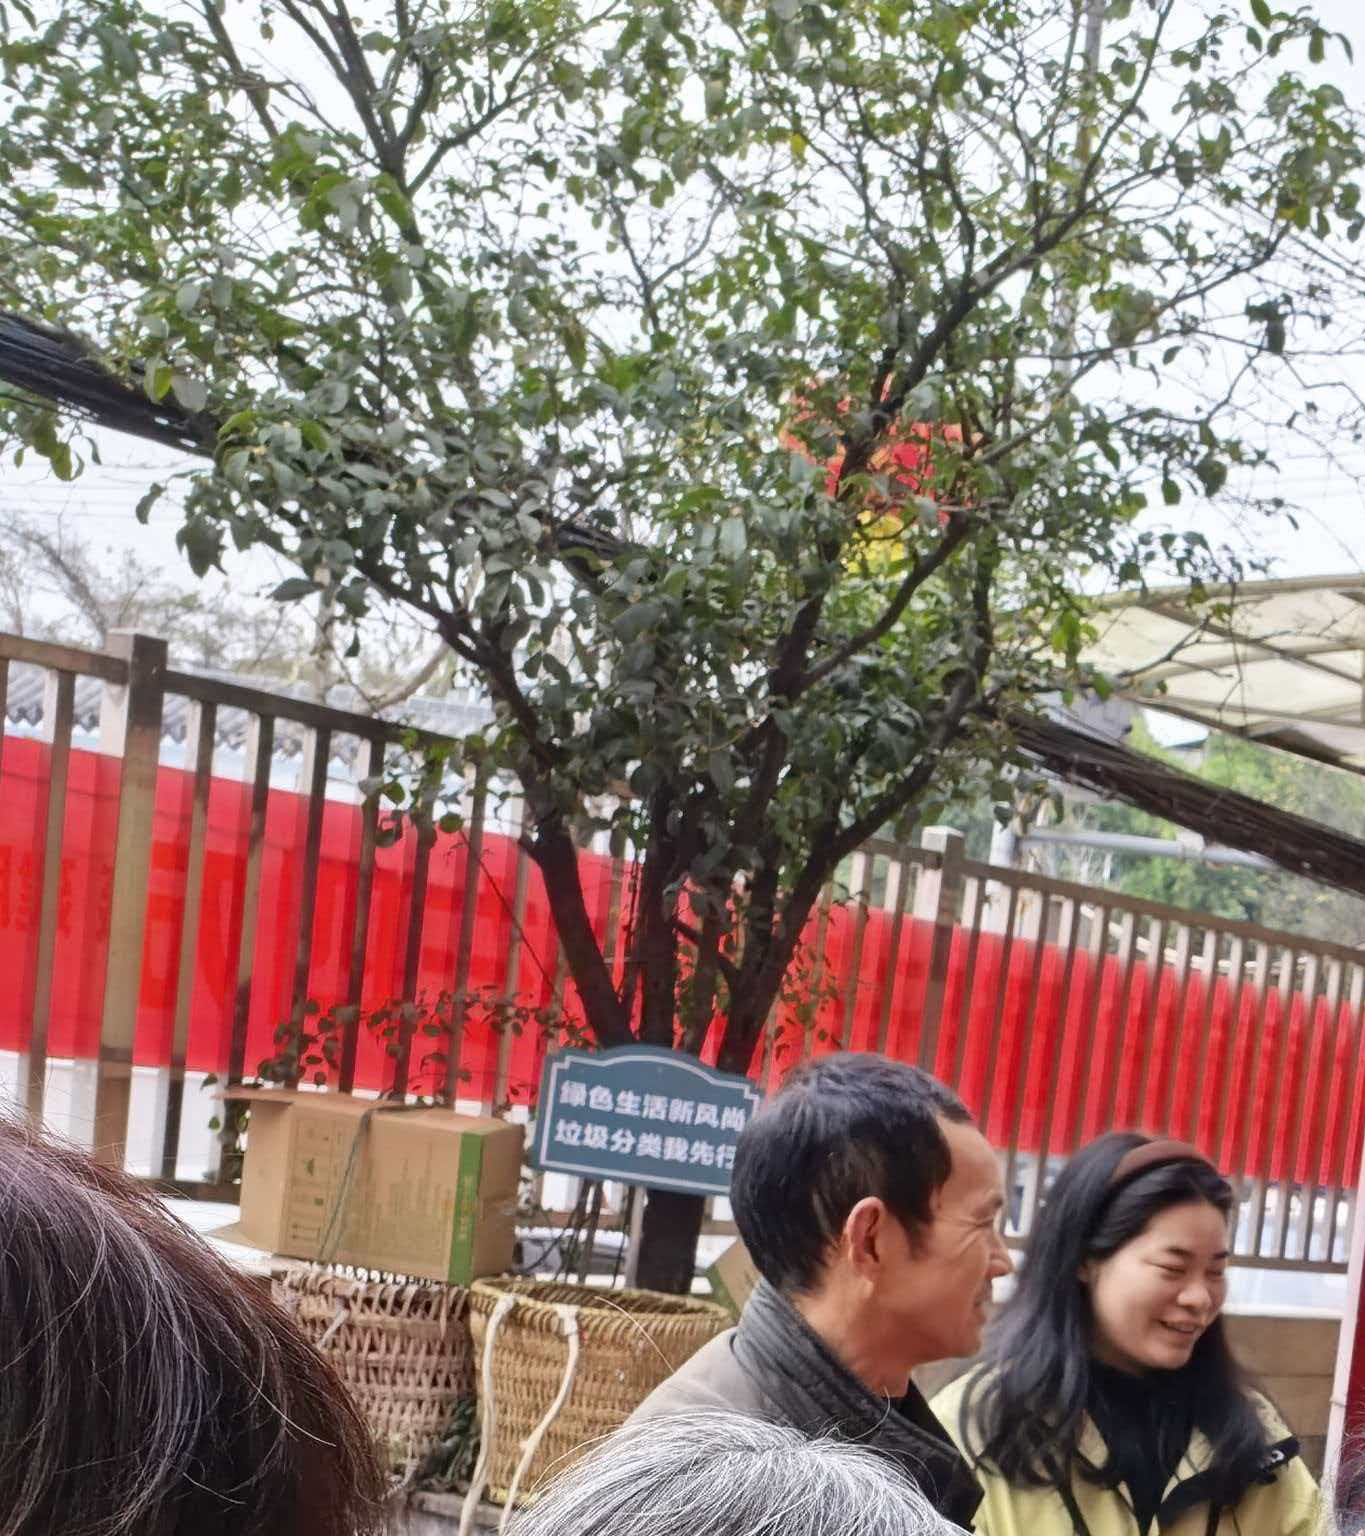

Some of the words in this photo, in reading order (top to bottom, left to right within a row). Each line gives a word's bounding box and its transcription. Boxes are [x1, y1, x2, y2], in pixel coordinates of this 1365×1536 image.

[559, 1079, 746, 1132] 绿色生活新风尚
[554, 1118, 738, 1170] 垃圾分类我先行
